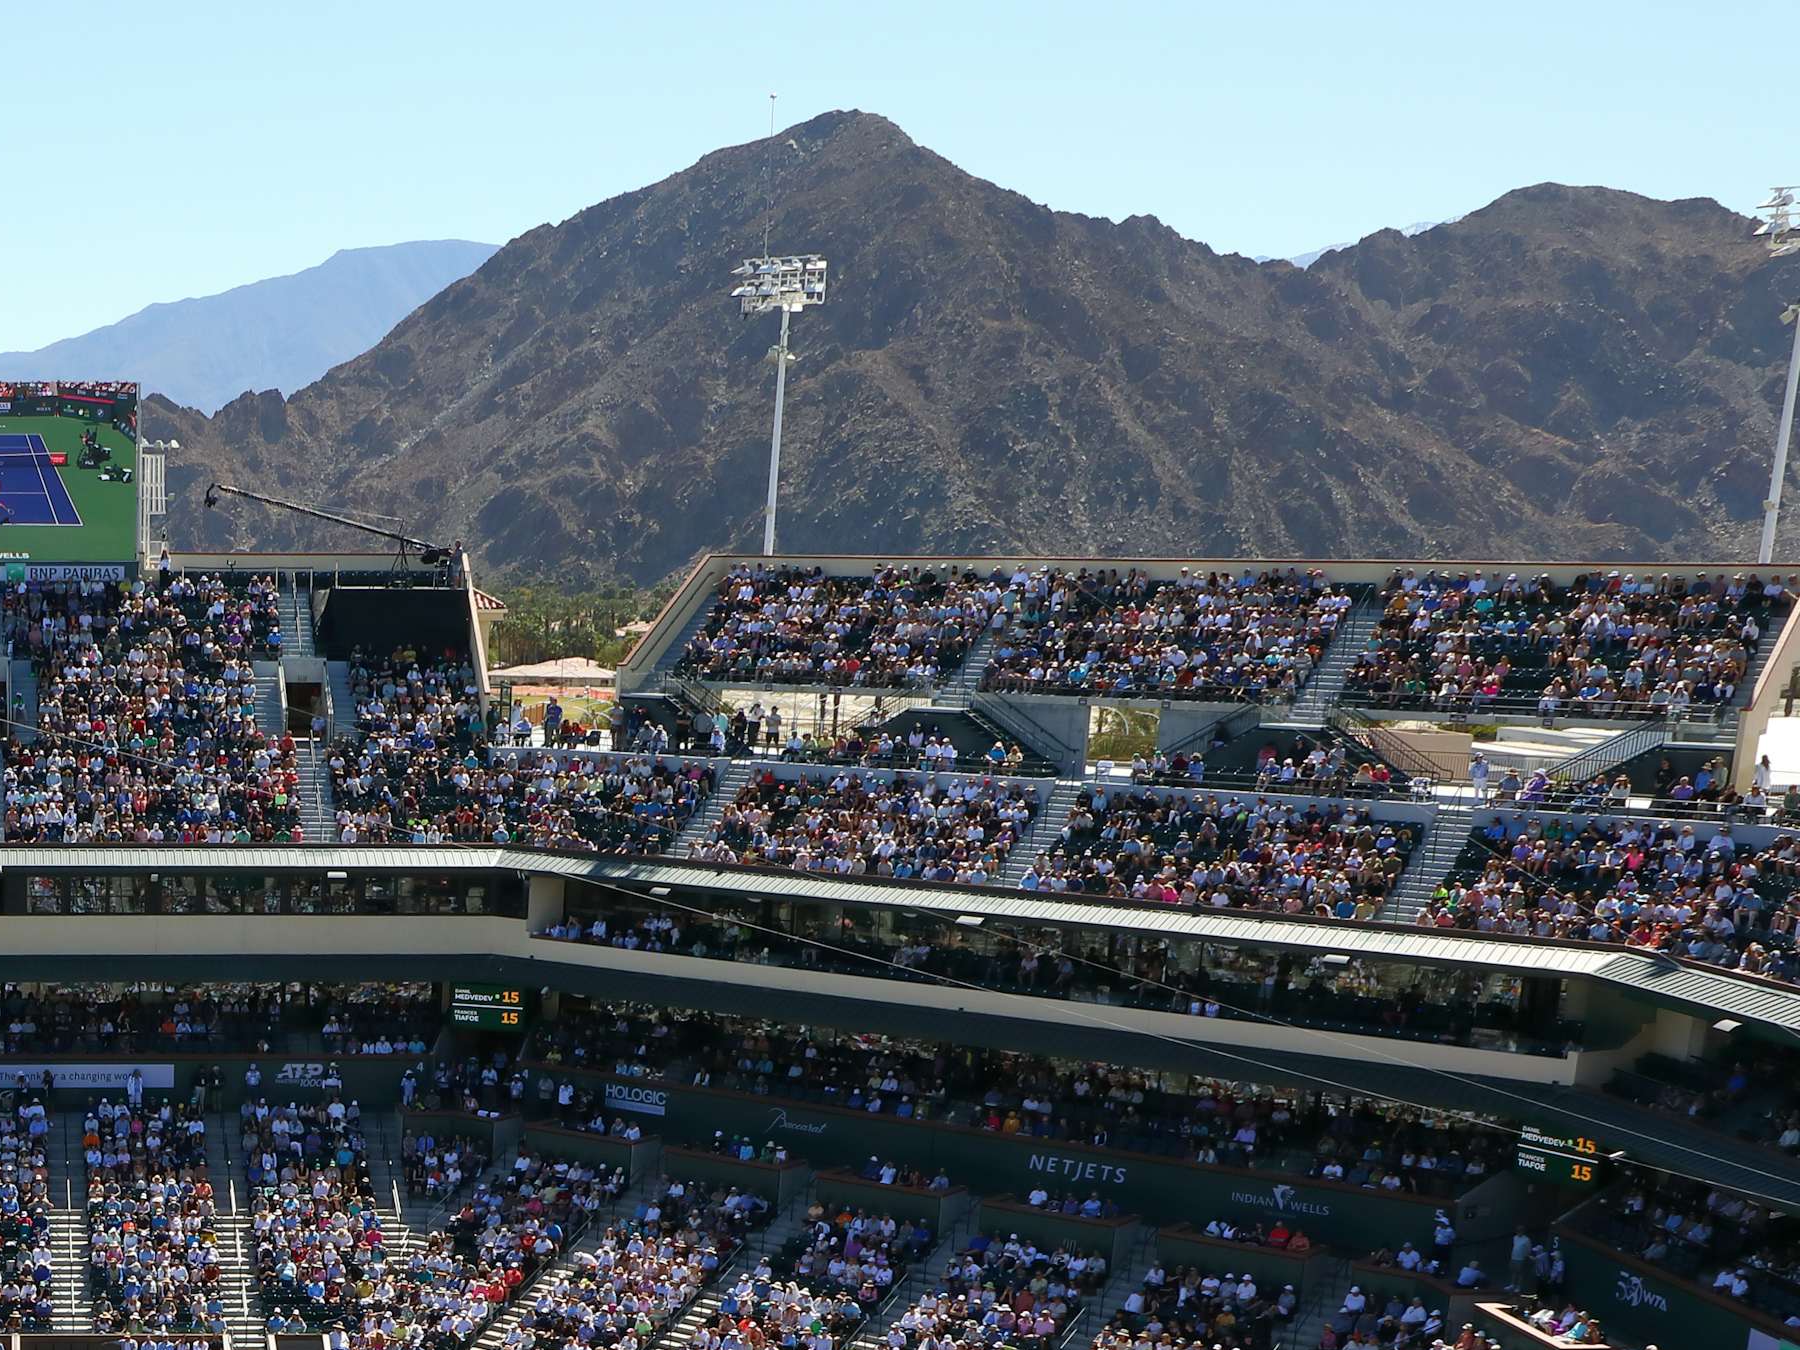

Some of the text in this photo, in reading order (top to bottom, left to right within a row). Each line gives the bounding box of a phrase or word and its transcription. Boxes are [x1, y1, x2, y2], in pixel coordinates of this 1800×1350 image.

[30, 567, 119, 579] BNP PARIBAS
[455, 991, 519, 1003] MEDVEDEV 15
[454, 1012, 518, 1024] TIAFOE 15
[0, 1072, 16, 1081] The
[68, 1071, 111, 1083] changing
[276, 1063, 323, 1079] ATP
[605, 1083, 666, 1106] HOLOGIC
[1521, 1132, 1596, 1153] MEDVEDEV 15
[1029, 1154, 1126, 1183] NETJETS
[1518, 1158, 1591, 1181] TIAFOE 15
[1231, 1191, 1275, 1207] INDIAN
[1290, 1201, 1329, 1216] WELLS
[1643, 1288, 1667, 1312] WTA
